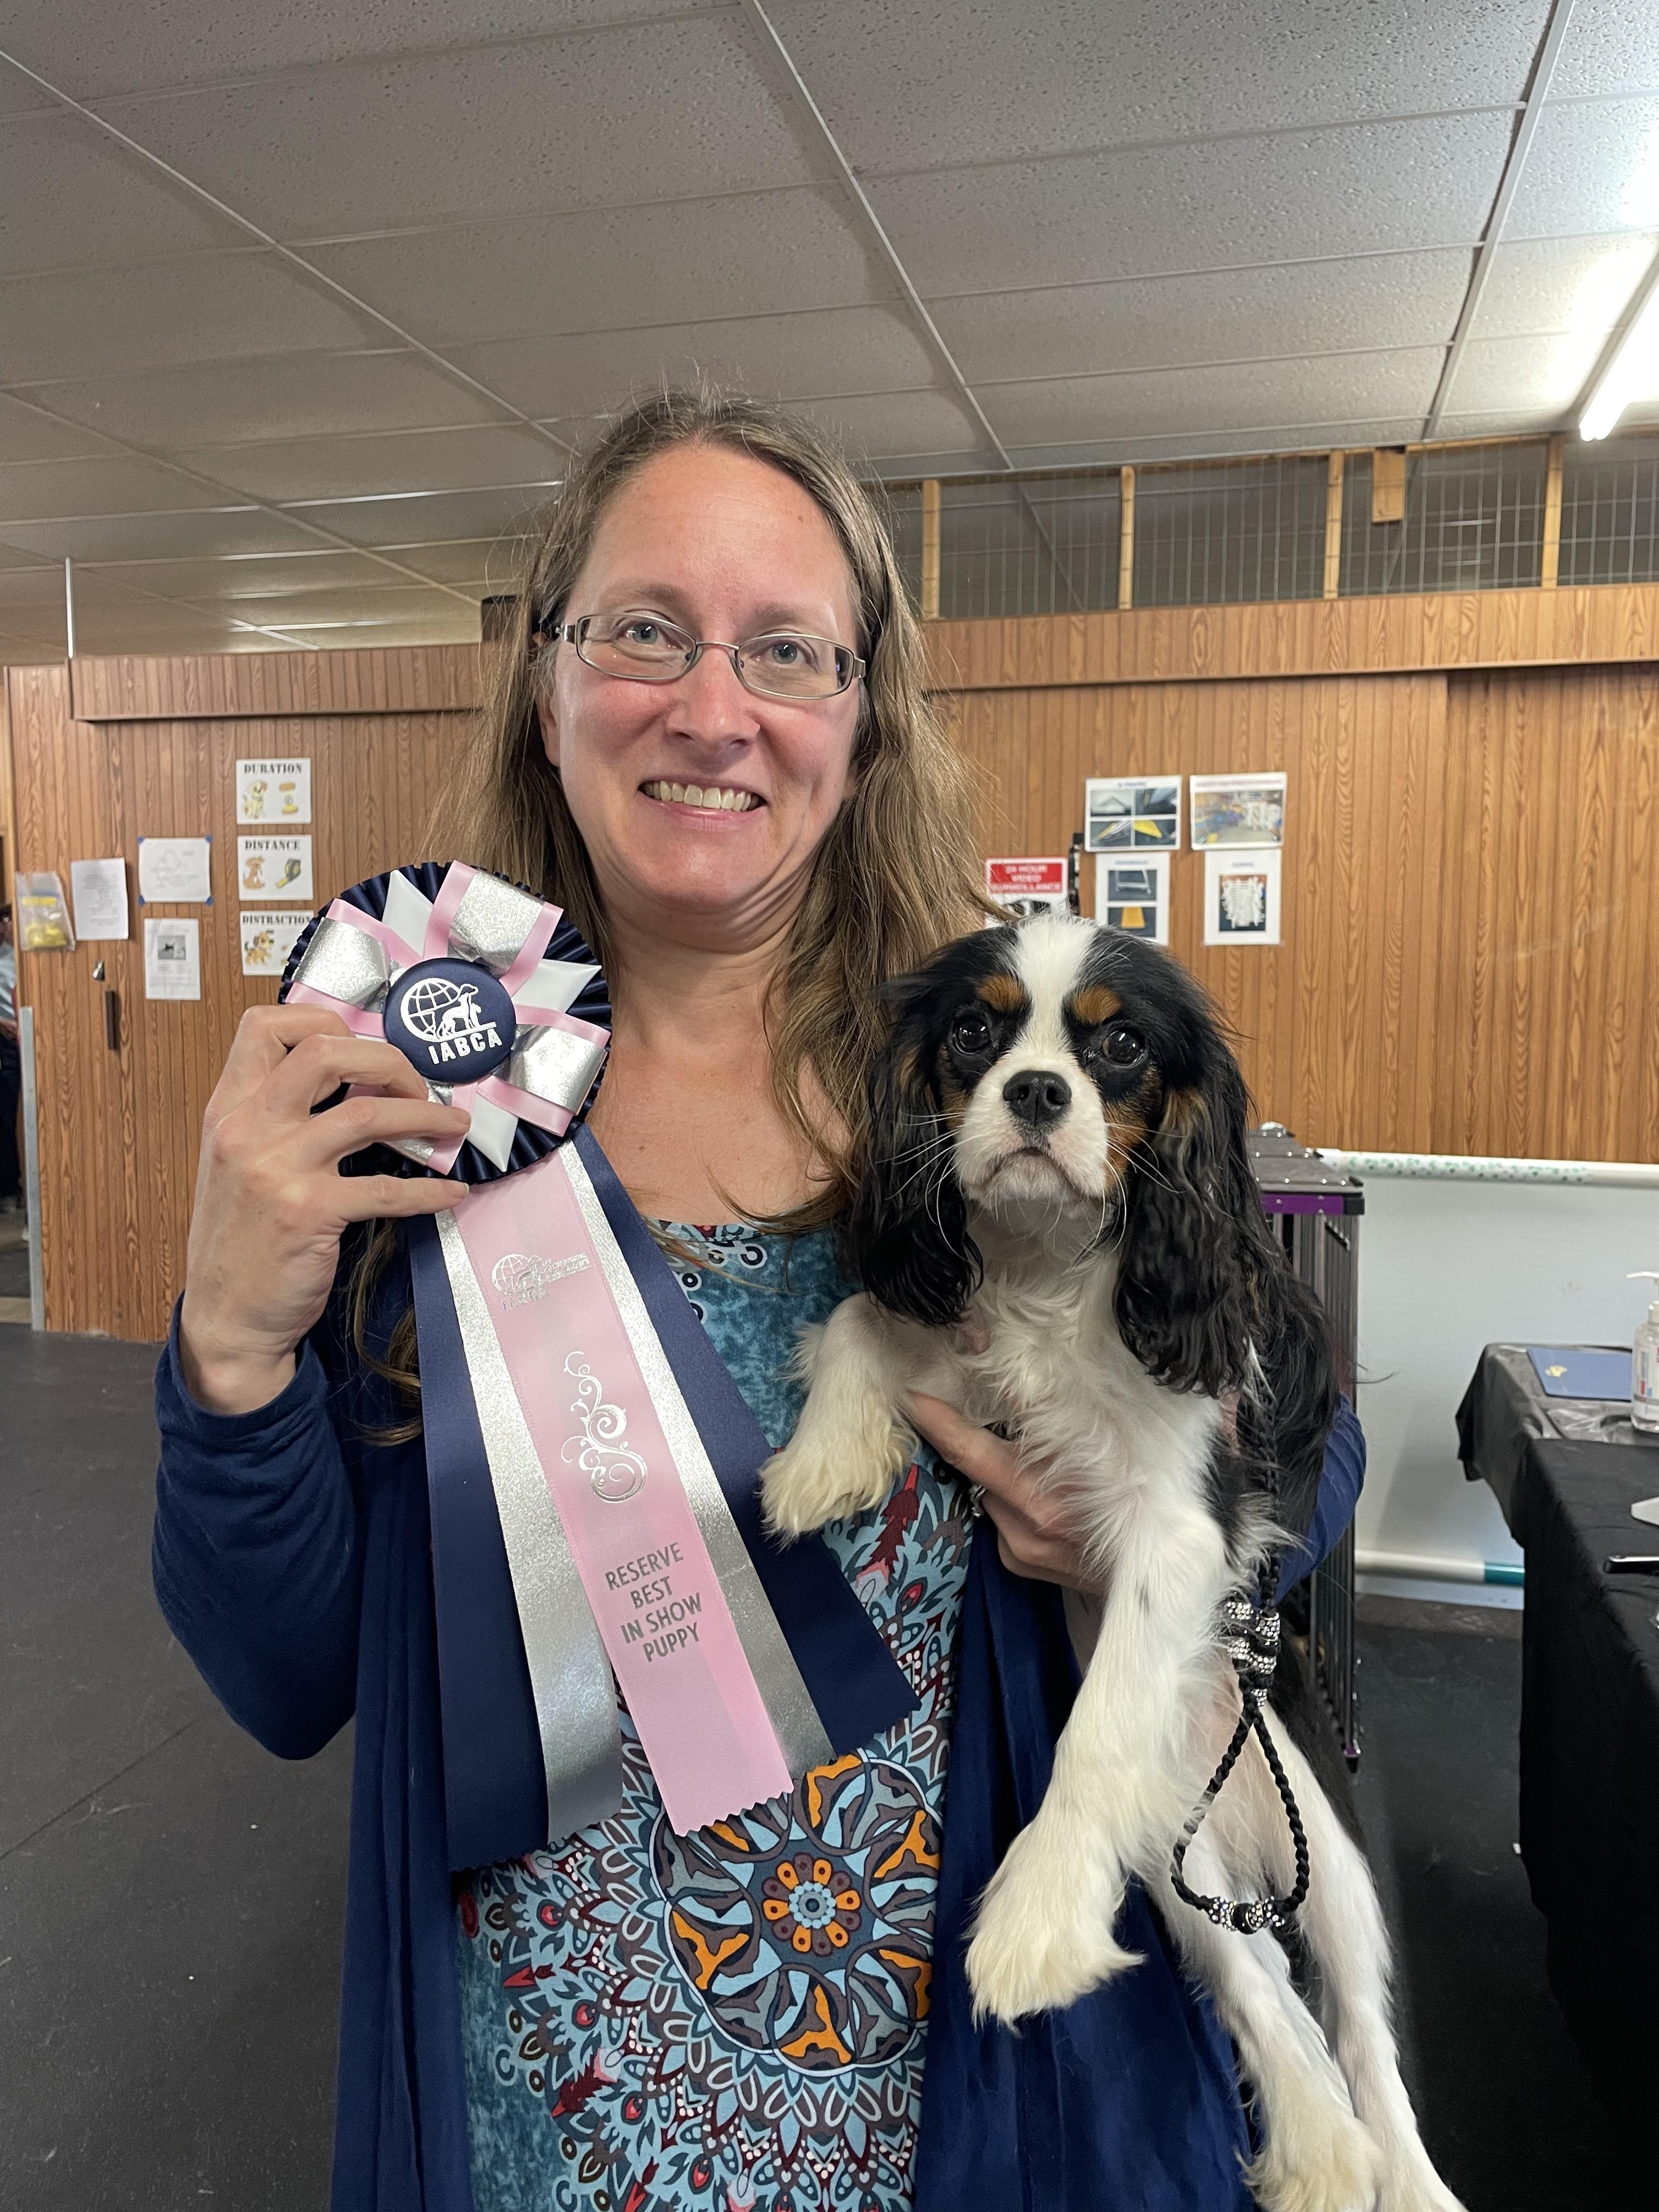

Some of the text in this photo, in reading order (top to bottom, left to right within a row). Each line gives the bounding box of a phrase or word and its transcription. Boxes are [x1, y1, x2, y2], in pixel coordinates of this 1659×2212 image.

[244, 763, 303, 774] DURATION
[245, 839, 301, 851] DISTANCE
[428, 1028, 503, 1064] IABCA
[605, 1542, 684, 1591] RESERVE
[630, 1576, 673, 1610] BEST
[620, 1592, 702, 1644] IN SHOW
[642, 1622, 699, 1662] PUPPY
